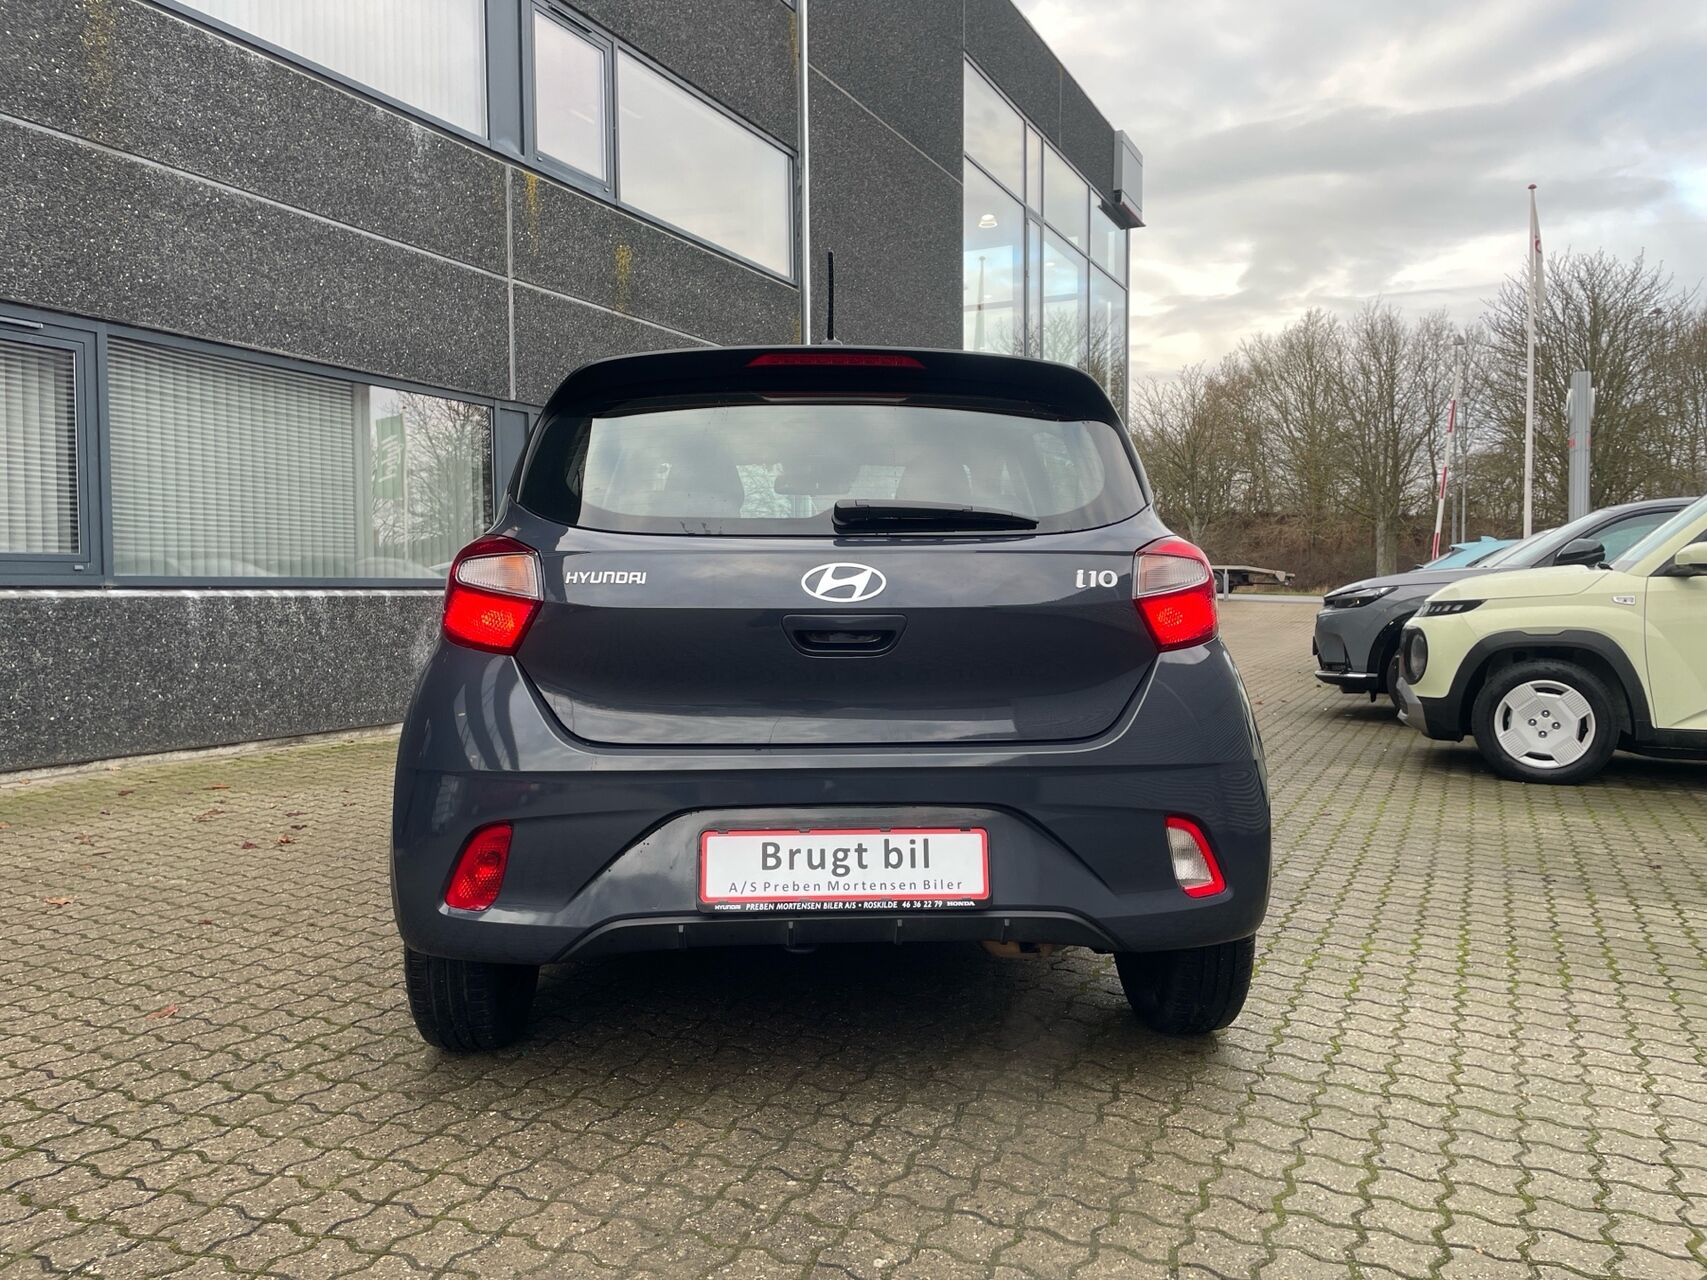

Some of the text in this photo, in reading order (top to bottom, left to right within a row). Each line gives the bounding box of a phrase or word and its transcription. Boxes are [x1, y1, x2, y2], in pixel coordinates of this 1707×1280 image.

[565, 571, 647, 584] HYUNDAI
[1075, 569, 1118, 589] i10
[761, 838, 930, 877] Brugt bil
[728, 879, 962, 895] A/S Preben Mortensen Biler
[745, 900, 943, 911] PREBEN MORTENSEN BILER A/S ROSKILDE 46 36 22 79
